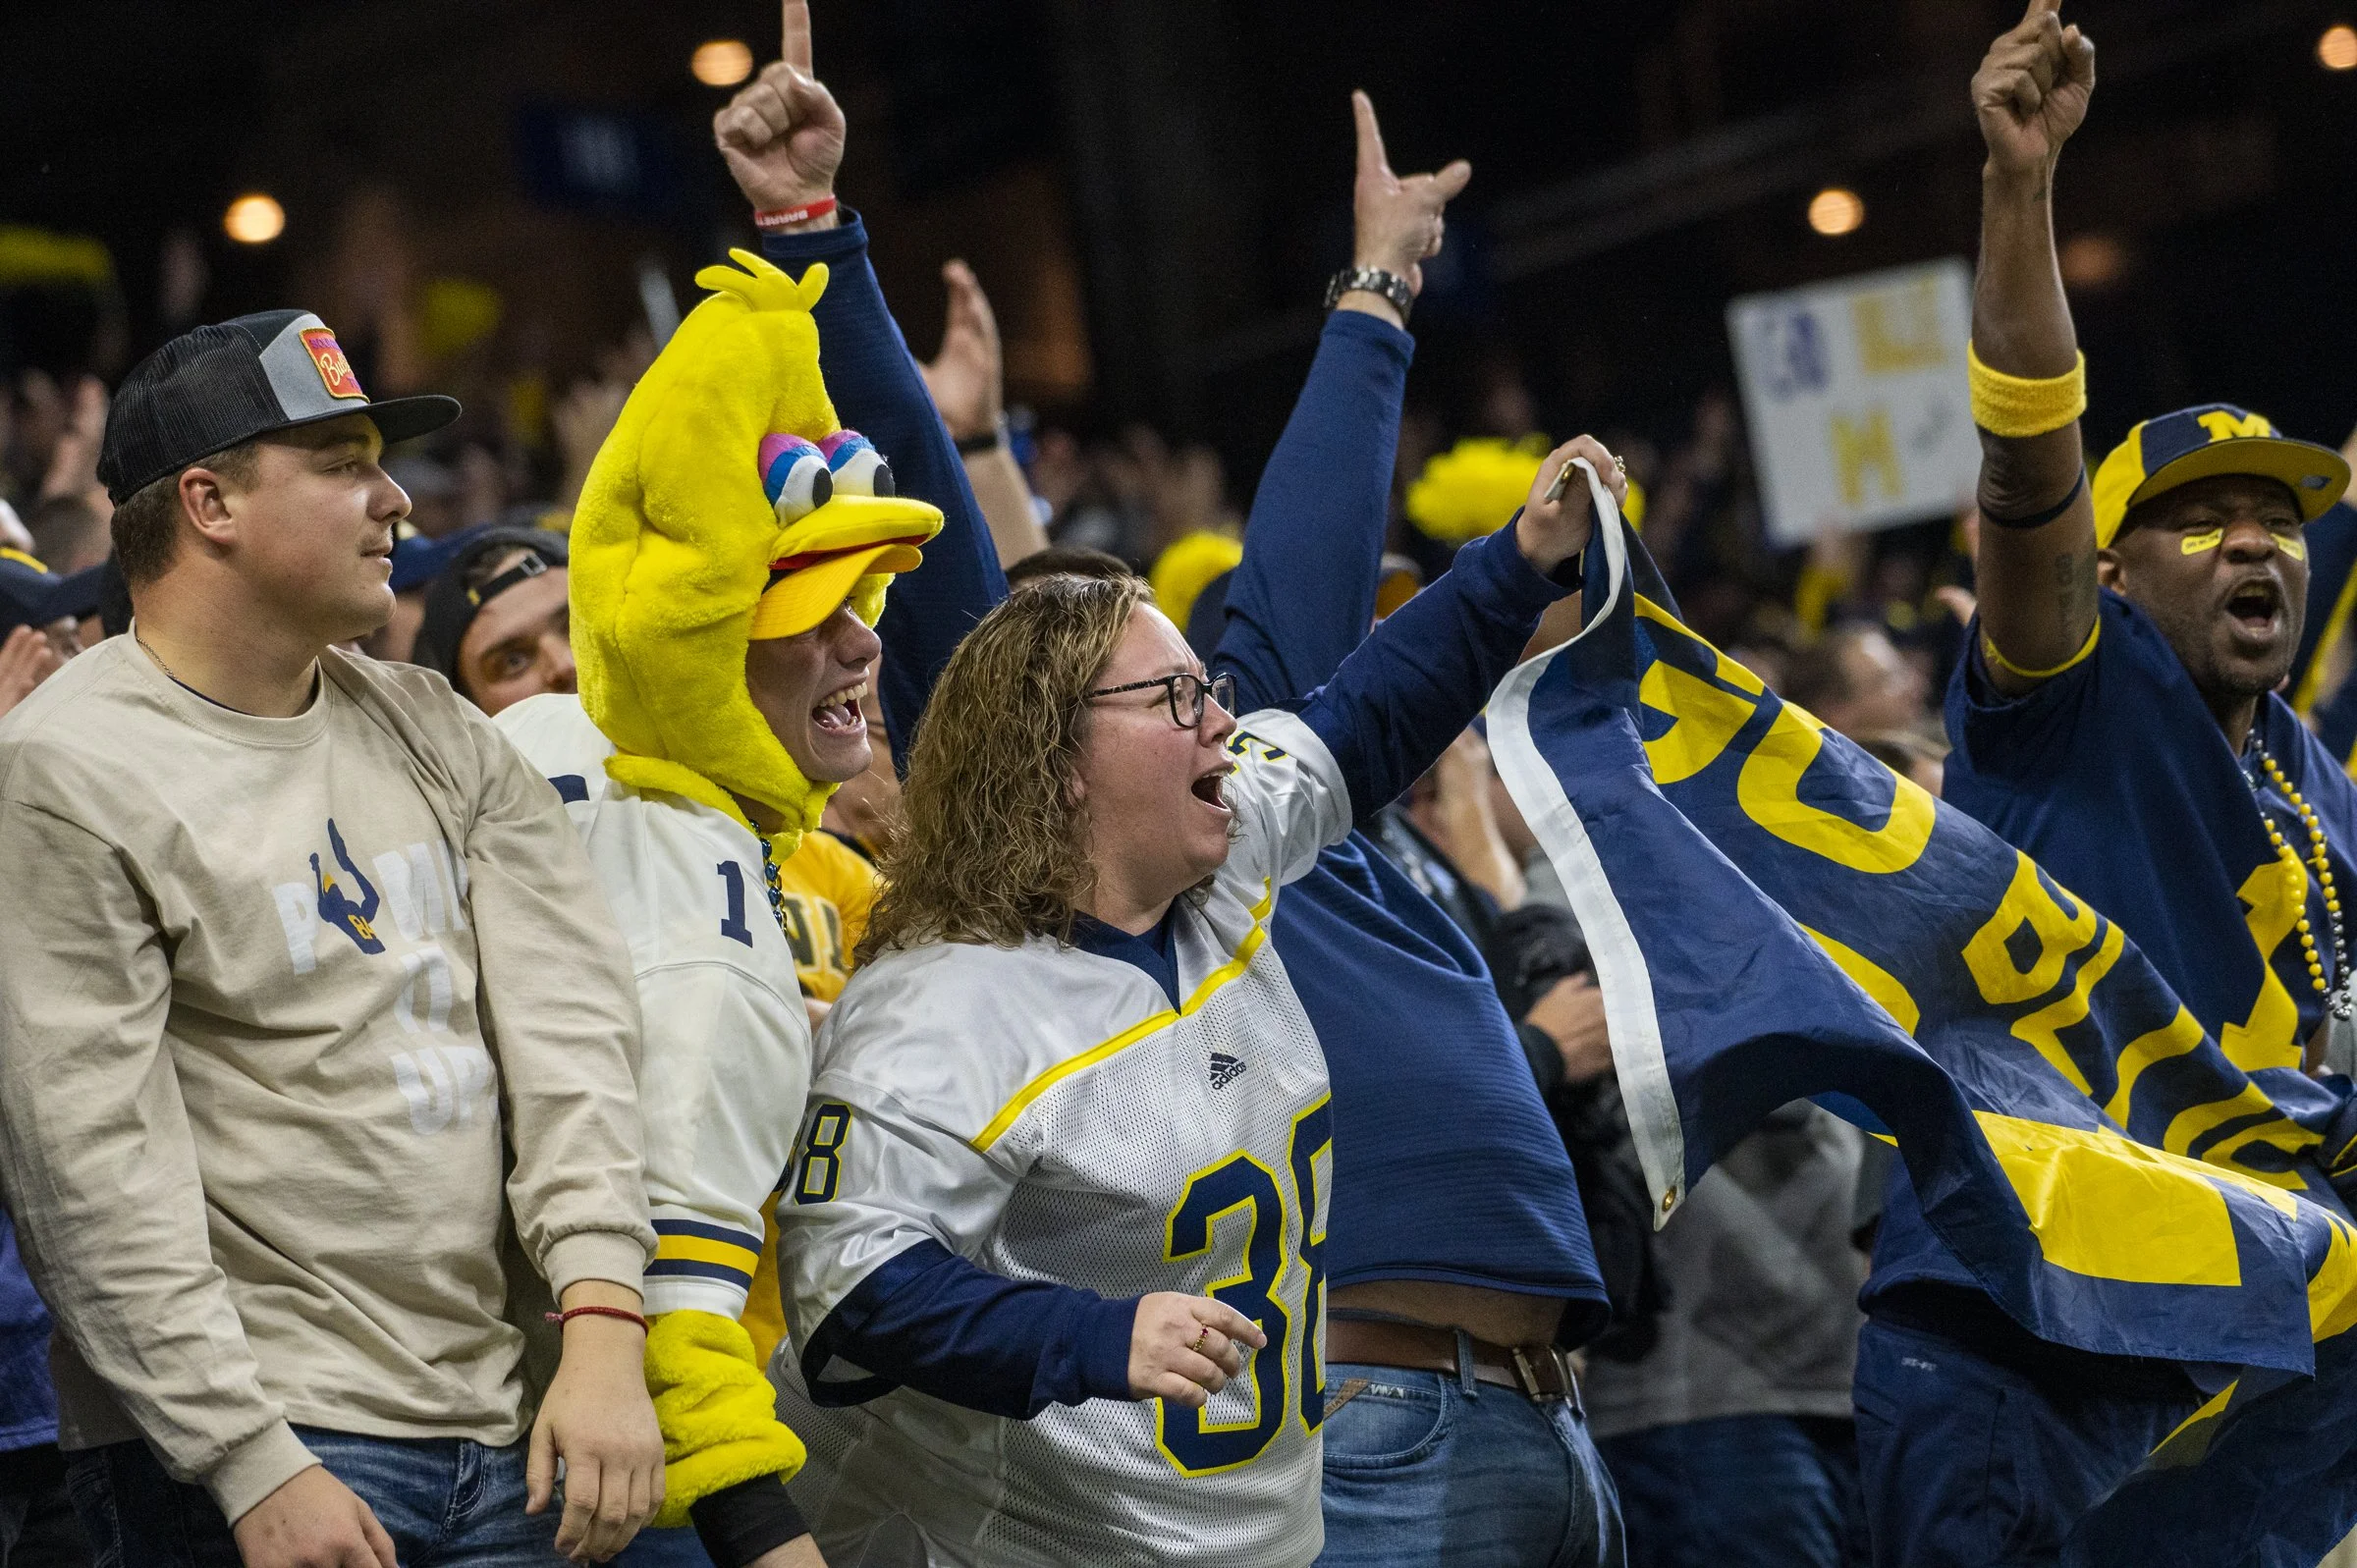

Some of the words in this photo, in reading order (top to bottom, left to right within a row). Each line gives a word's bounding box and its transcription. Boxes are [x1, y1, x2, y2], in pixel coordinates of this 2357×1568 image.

[2197, 410, 2272, 443] M
[717, 860, 753, 948] 1
[1212, 1061, 1247, 1090] adidas
[785, 1102, 853, 1207] 8
